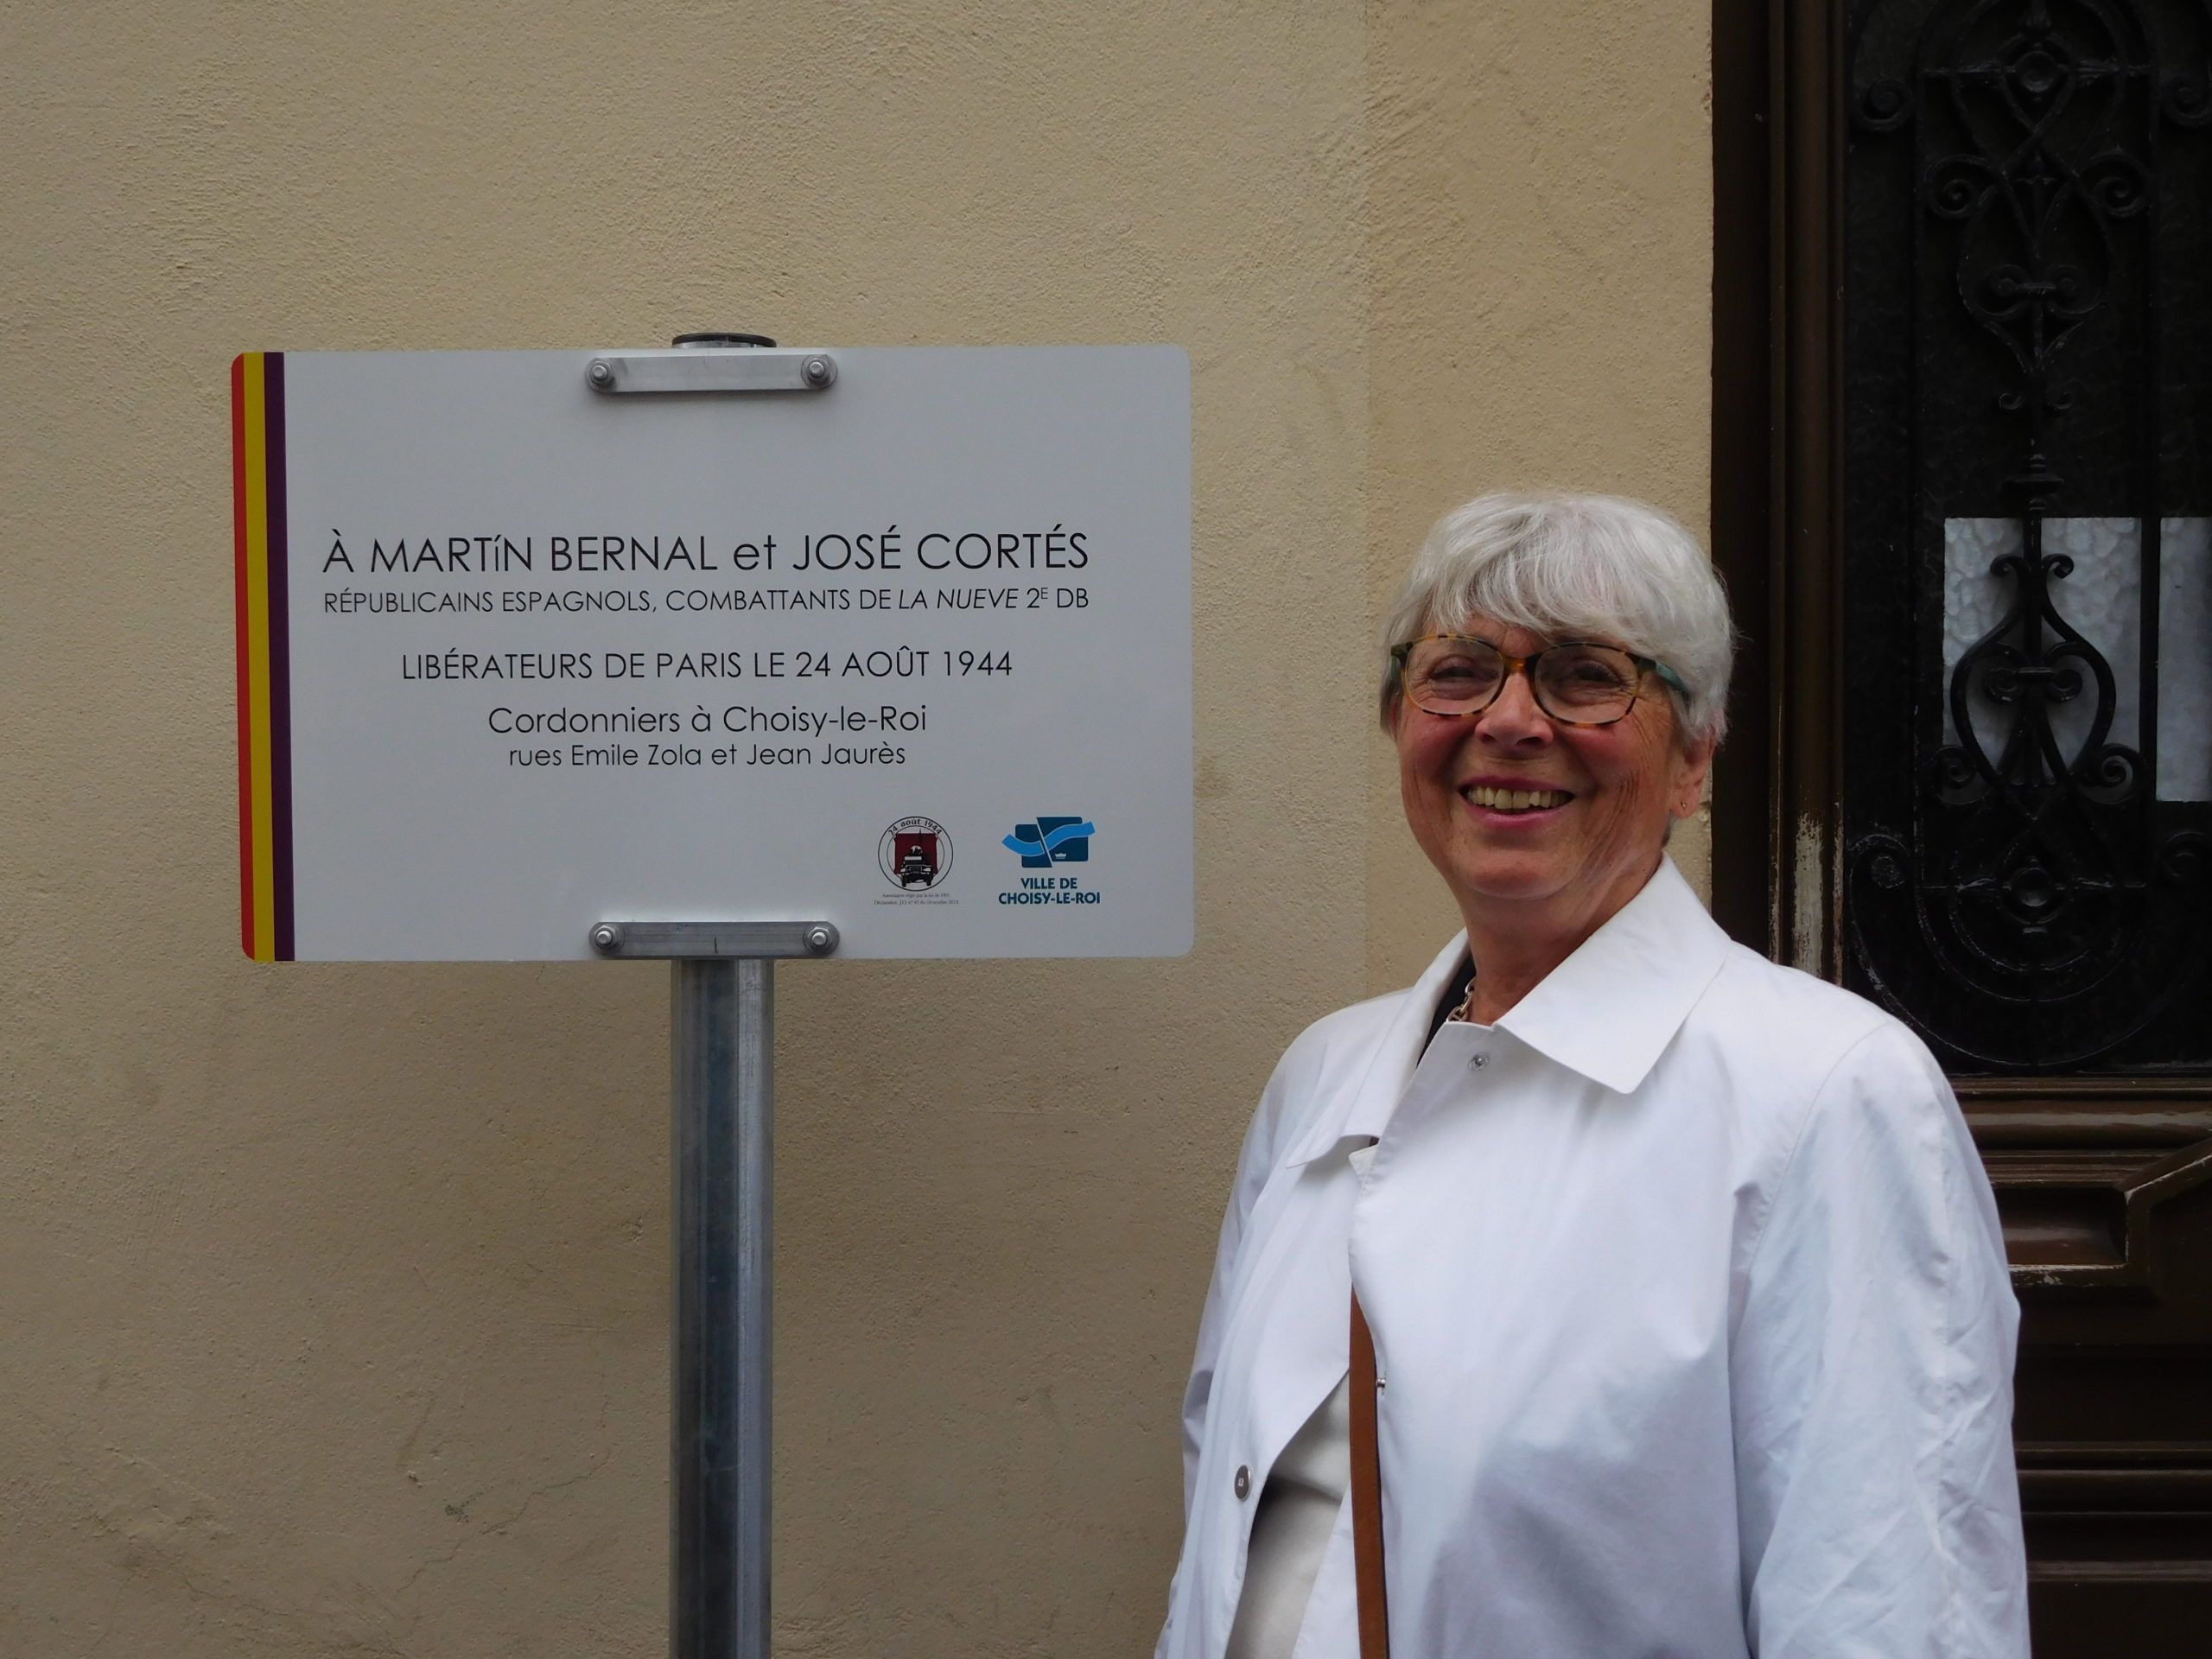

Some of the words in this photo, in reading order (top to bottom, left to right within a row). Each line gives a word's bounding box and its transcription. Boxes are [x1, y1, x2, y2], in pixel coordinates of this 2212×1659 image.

[321, 528, 355, 574] À
[550, 535, 718, 572] BERNAL
[733, 534, 778, 571] et
[791, 524, 901, 571] JOSÉ
[917, 523, 1089, 570] CORTÉS
[324, 587, 493, 613] RÉPUBLICAINS
[502, 589, 658, 613] ESPAGNOLS,
[665, 588, 850, 612] COMBATTANTS
[859, 588, 892, 610] DE
[899, 588, 928, 610] LA
[937, 588, 1020, 610] NUEVE
[1056, 588, 1090, 608] DB
[403, 646, 593, 680] LIBÉRATEURS
[605, 652, 645, 678] DE
[657, 652, 742, 678] PARIS
[753, 652, 785, 677] LE
[795, 651, 831, 677] 24
[841, 645, 930, 677] AOÛT
[943, 650, 1013, 677] 1944
[488, 706, 681, 734] Cordonniers
[690, 704, 711, 733] à
[722, 704, 926, 738] Choisy-le-Roi
[509, 749, 563, 766] rues
[571, 743, 639, 766] Emile
[647, 743, 702, 766] Zola
[710, 743, 738, 766] et
[746, 743, 811, 766] Jean
[820, 741, 906, 766] Jaurès
[888, 826, 898, 836] 24
[925, 820, 942, 835] 1944
[1020, 877, 1056, 890] VILLE
[1059, 877, 1078, 890] DE
[998, 891, 1101, 906] CHOISY-LE-ROI
